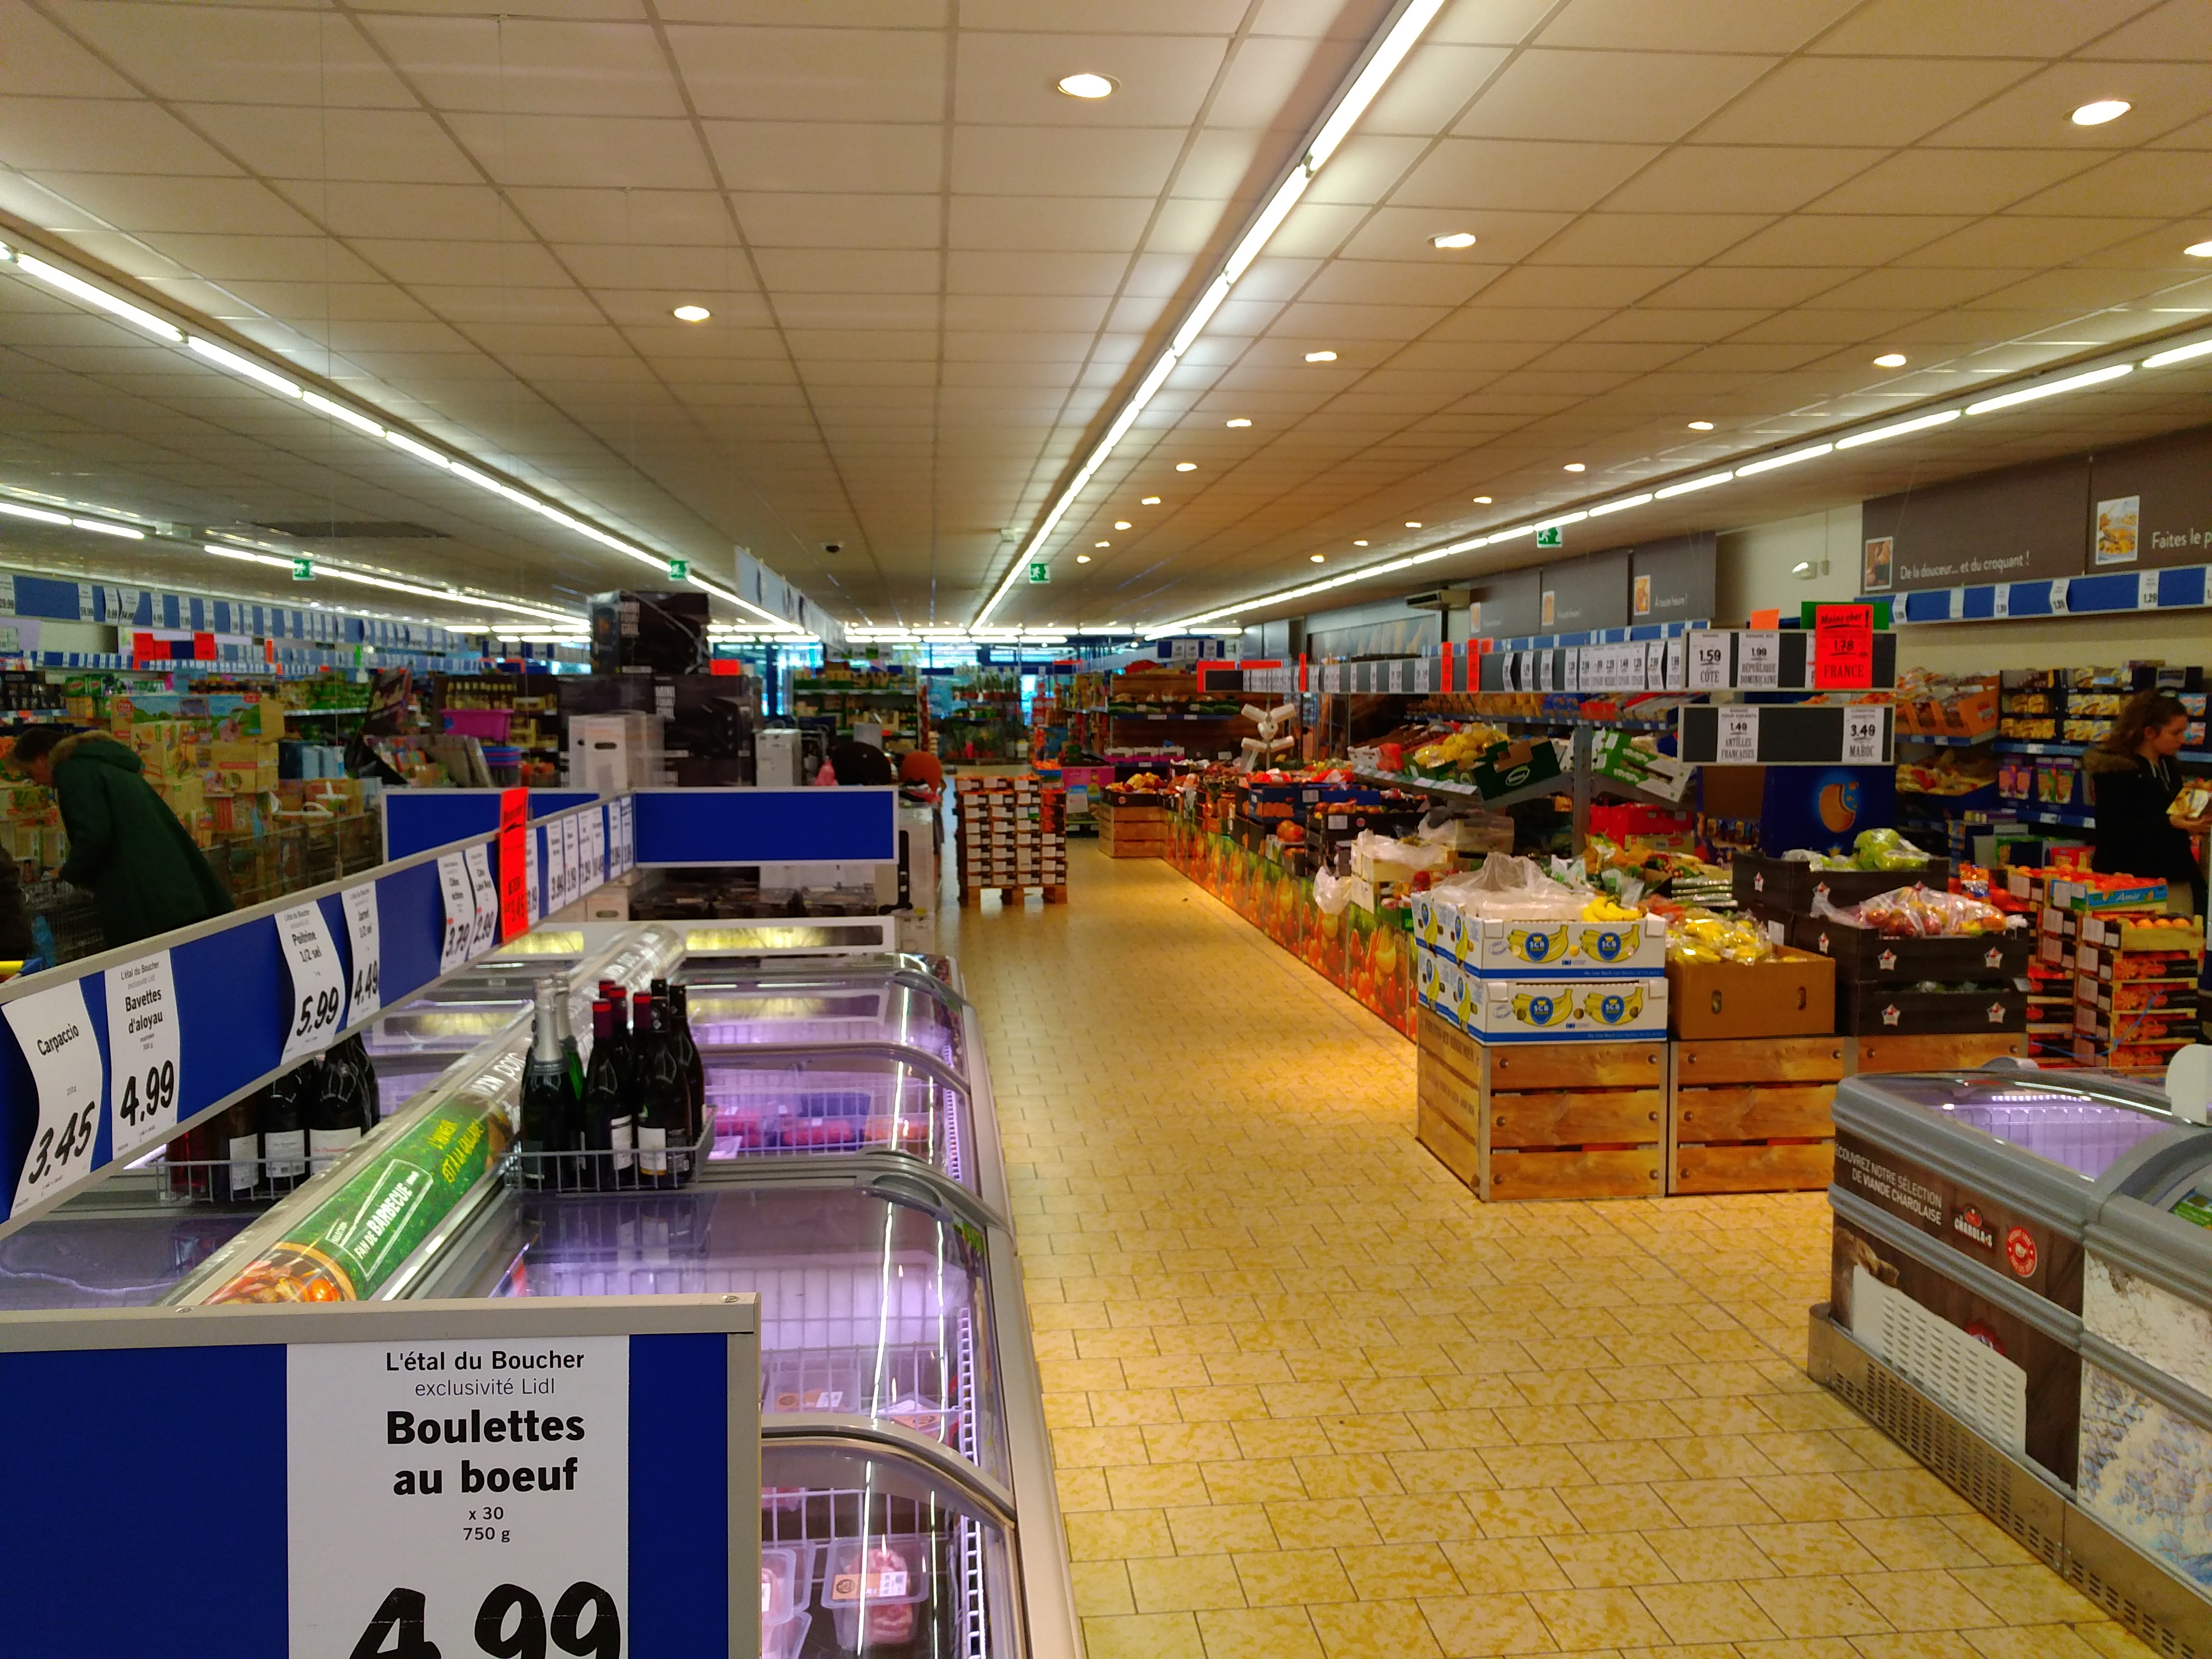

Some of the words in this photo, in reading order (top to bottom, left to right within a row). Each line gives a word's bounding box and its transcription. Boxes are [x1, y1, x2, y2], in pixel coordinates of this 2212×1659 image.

[2151, 530, 2187, 550] Faites
[2190, 526, 2201, 545] le
[1900, 564, 1912, 580] De
[1913, 563, 1920, 578] la
[1960, 561, 1969, 574] et
[1970, 555, 1982, 572] du
[1983, 554, 2023, 573] croquant
[1821, 613, 1844, 624] Moins
[1846, 611, 1863, 622] cher
[1833, 640, 1854, 651] 1.78
[1740, 674, 1777, 684] DOMINICAINE
[1823, 664, 1864, 678] FRANCE
[292, 929, 316, 947] Poitrine
[299, 949, 312, 963] 1/2
[311, 944, 323, 959] sel
[121, 968, 134, 981] L'étal
[134, 967, 141, 976] du
[141, 961, 159, 974] Boucher
[354, 959, 378, 1006] 4.49
[125, 988, 162, 1012] Bavettes
[296, 986, 339, 1037] 5.99
[128, 1011, 163, 1034] d'aloyau
[37, 1023, 80, 1056] Carpaccio
[120, 1059, 174, 1126] 4.99
[28, 1101, 95, 1184] 3.45
[1835, 1143, 1871, 1173] ÉCOUVREZ
[1871, 1161, 1896, 1186] NOTRE
[1897, 1174, 1942, 1209] SÉLECTION
[1852, 1167, 1863, 1184] DE
[1863, 1171, 1891, 1198] VIANDE
[1891, 1188, 1942, 1226] CHAROLAISE
[366, 1182, 413, 1237] BARBECUE
[354, 1238, 371, 1260] FAN
[366, 1230, 379, 1247] DE
[386, 1350, 446, 1372] L'étal
[454, 1350, 482, 1370] du
[491, 1350, 585, 1370] Boucher
[414, 1378, 515, 1397] exclusivité
[522, 1377, 556, 1395] Lidl
[386, 1409, 586, 1445] Boulettes
[393, 1468, 443, 1495] au
[461, 1457, 579, 1494] boeuf
[468, 1509, 477, 1521] x
[482, 1506, 505, 1521] 30
[462, 1527, 496, 1542] 750
[501, 1529, 511, 1543] g
